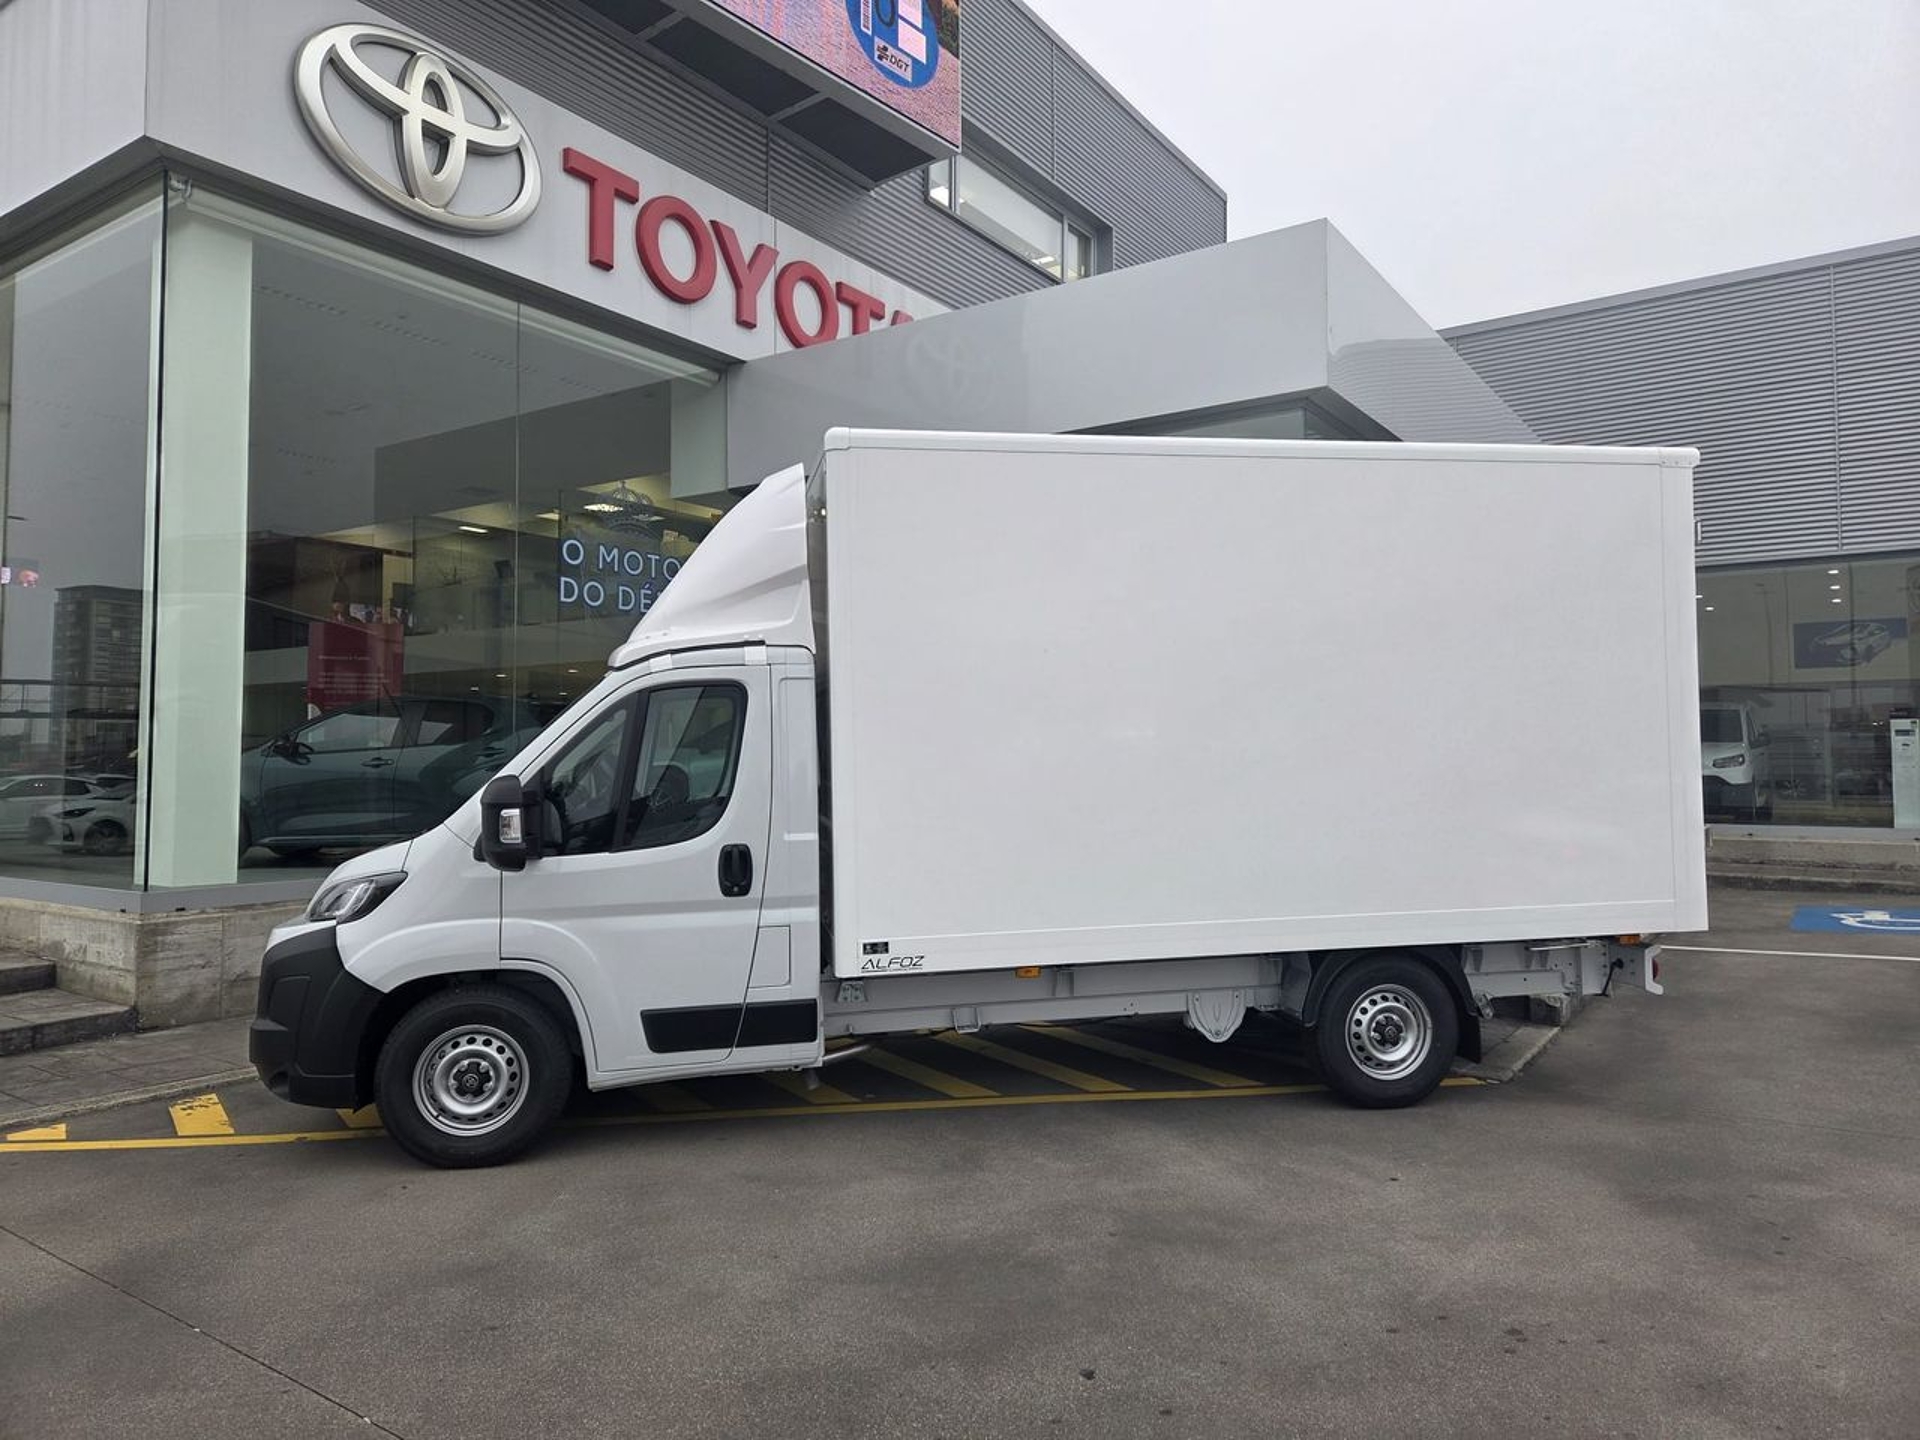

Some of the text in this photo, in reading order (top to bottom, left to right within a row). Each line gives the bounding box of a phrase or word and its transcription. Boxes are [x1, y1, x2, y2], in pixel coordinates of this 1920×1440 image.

[889, 54, 910, 73] DGT
[563, 147, 914, 348] TOYOT
[562, 539, 585, 565] O
[560, 577, 661, 613] DO DÉ
[861, 955, 925, 970] ALFOZ
